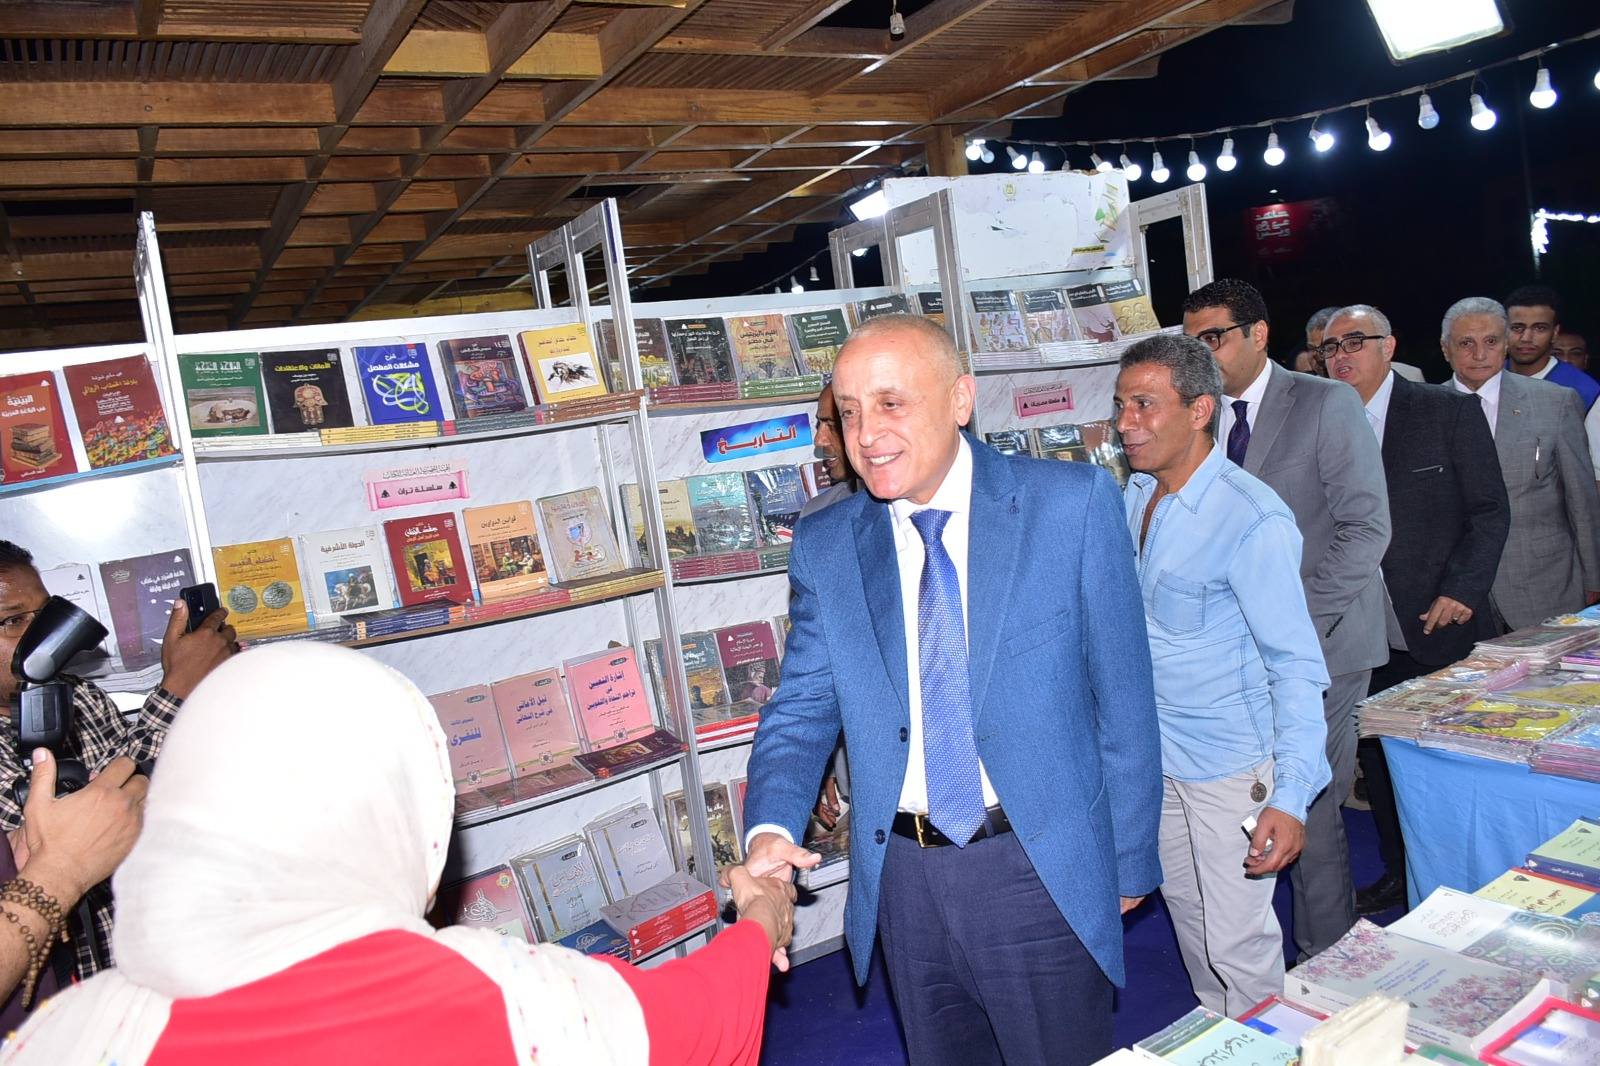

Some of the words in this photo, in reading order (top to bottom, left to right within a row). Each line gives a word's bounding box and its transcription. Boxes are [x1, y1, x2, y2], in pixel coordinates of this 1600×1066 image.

[384, 353, 397, 361] شرح
[367, 364, 393, 372] المفصل
[394, 361, 420, 370] مشكلات
[717, 425, 797, 454] التاريخ
[397, 487, 414, 496] تراث
[415, 484, 443, 493] سلسلة
[480, 518, 501, 529] الدواوين
[501, 514, 517, 525] قوانين
[349, 540, 366, 549] الدولة
